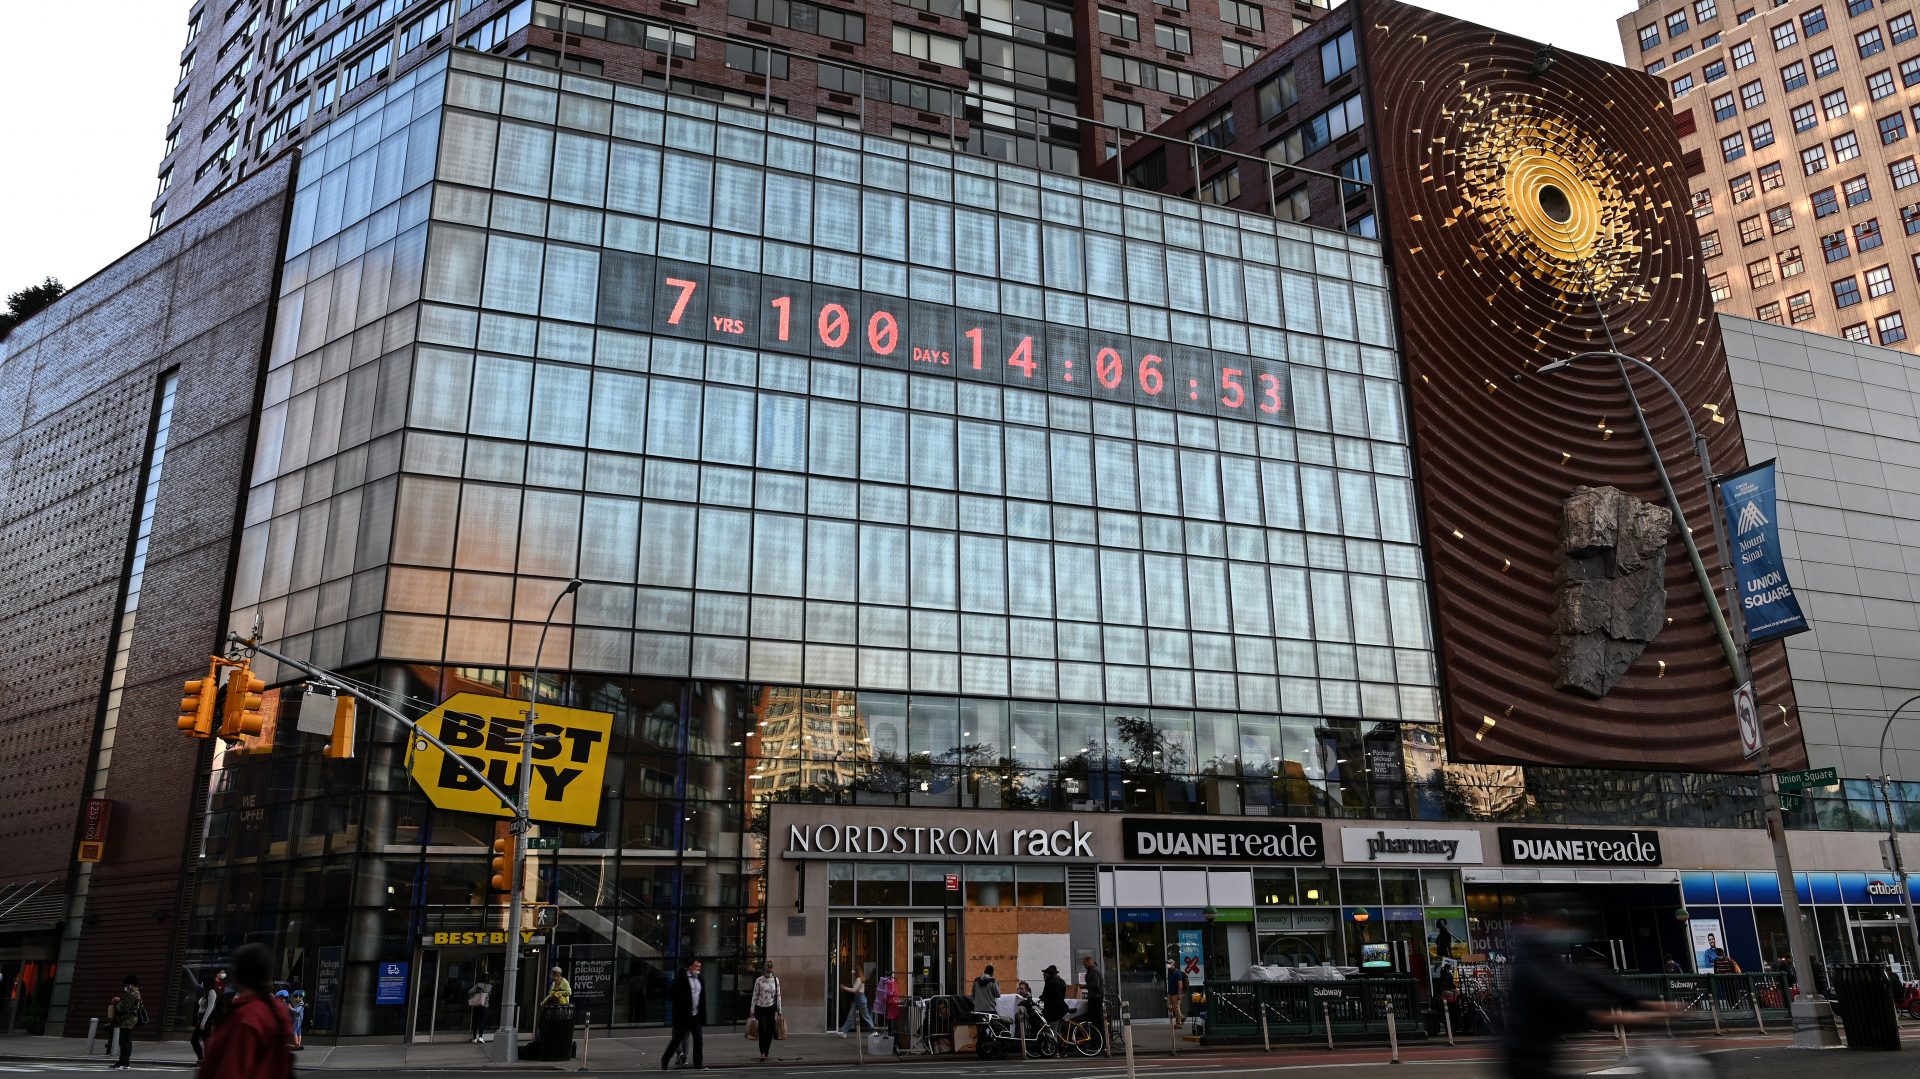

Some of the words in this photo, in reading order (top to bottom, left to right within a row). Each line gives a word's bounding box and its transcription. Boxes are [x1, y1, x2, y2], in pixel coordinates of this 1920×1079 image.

[666, 277, 697, 325] 7
[712, 316, 745, 335] YRS
[770, 296, 899, 356] 100
[913, 347, 951, 366] DAYS
[1738, 532, 1766, 553] Mount
[1741, 546, 1764, 564] Sinai
[1747, 570, 1782, 592] UNION
[1744, 583, 1792, 609] SQUARE
[438, 709, 603, 764] BEST
[437, 752, 583, 802] BUY
[1778, 774, 1802, 784] Union
[1804, 770, 1834, 783] Square
[242, 794, 256, 807] WE
[789, 824, 999, 856] NORDSTROM
[1013, 820, 1095, 857] rack
[1366, 831, 1460, 860] pharmacy
[434, 932, 487, 945] BEST
[489, 931, 535, 945] BY
[575, 966, 605, 975] pickup
[1313, 987, 1343, 998] Subway
[1670, 980, 1694, 990] Subway
